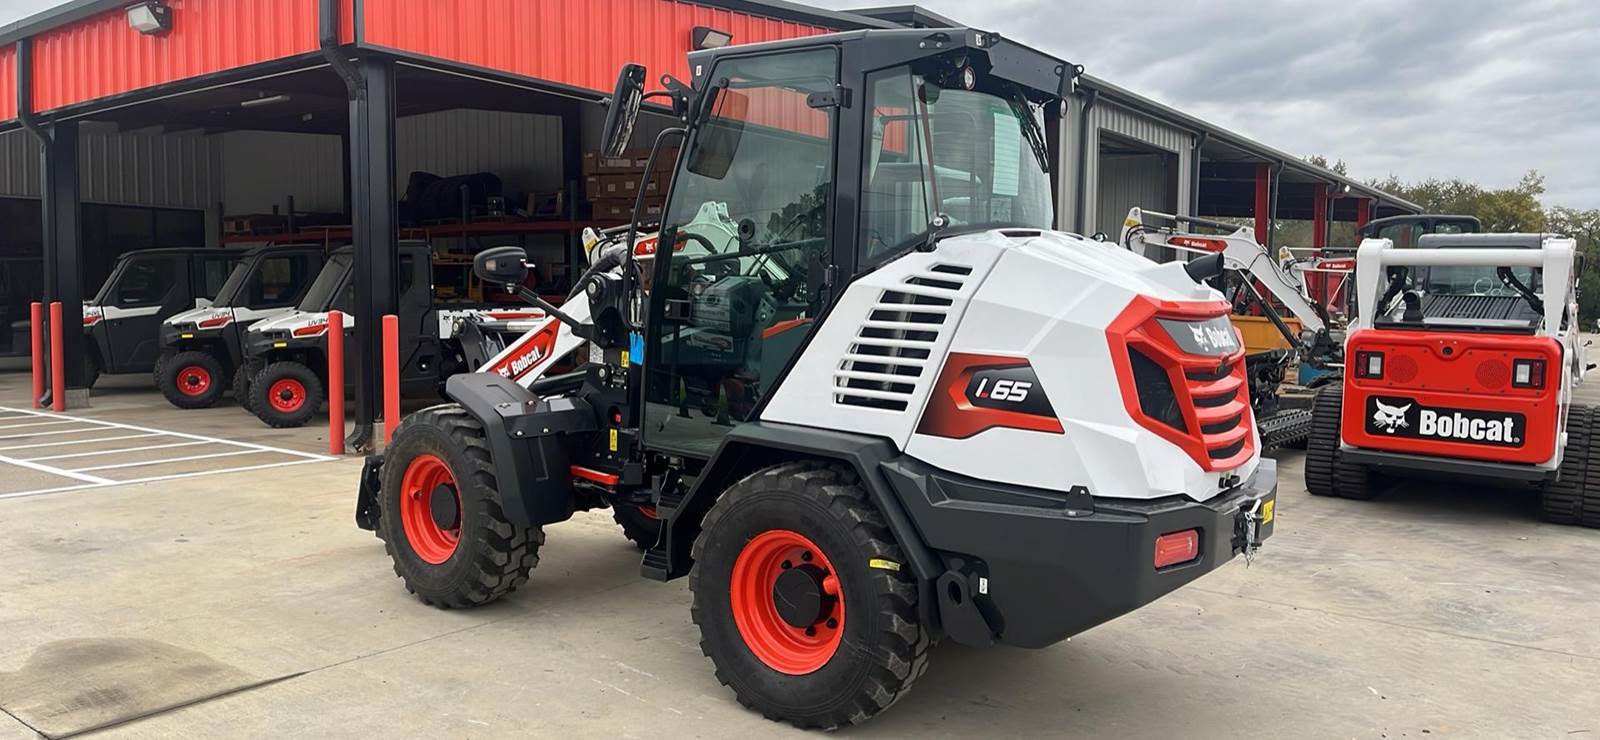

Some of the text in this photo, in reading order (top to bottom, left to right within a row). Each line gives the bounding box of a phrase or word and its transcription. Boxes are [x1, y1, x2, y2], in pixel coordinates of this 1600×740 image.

[1205, 326, 1236, 348] Bobcat
[511, 345, 541, 375] Bobcat
[1419, 409, 1514, 443] Bobcat
